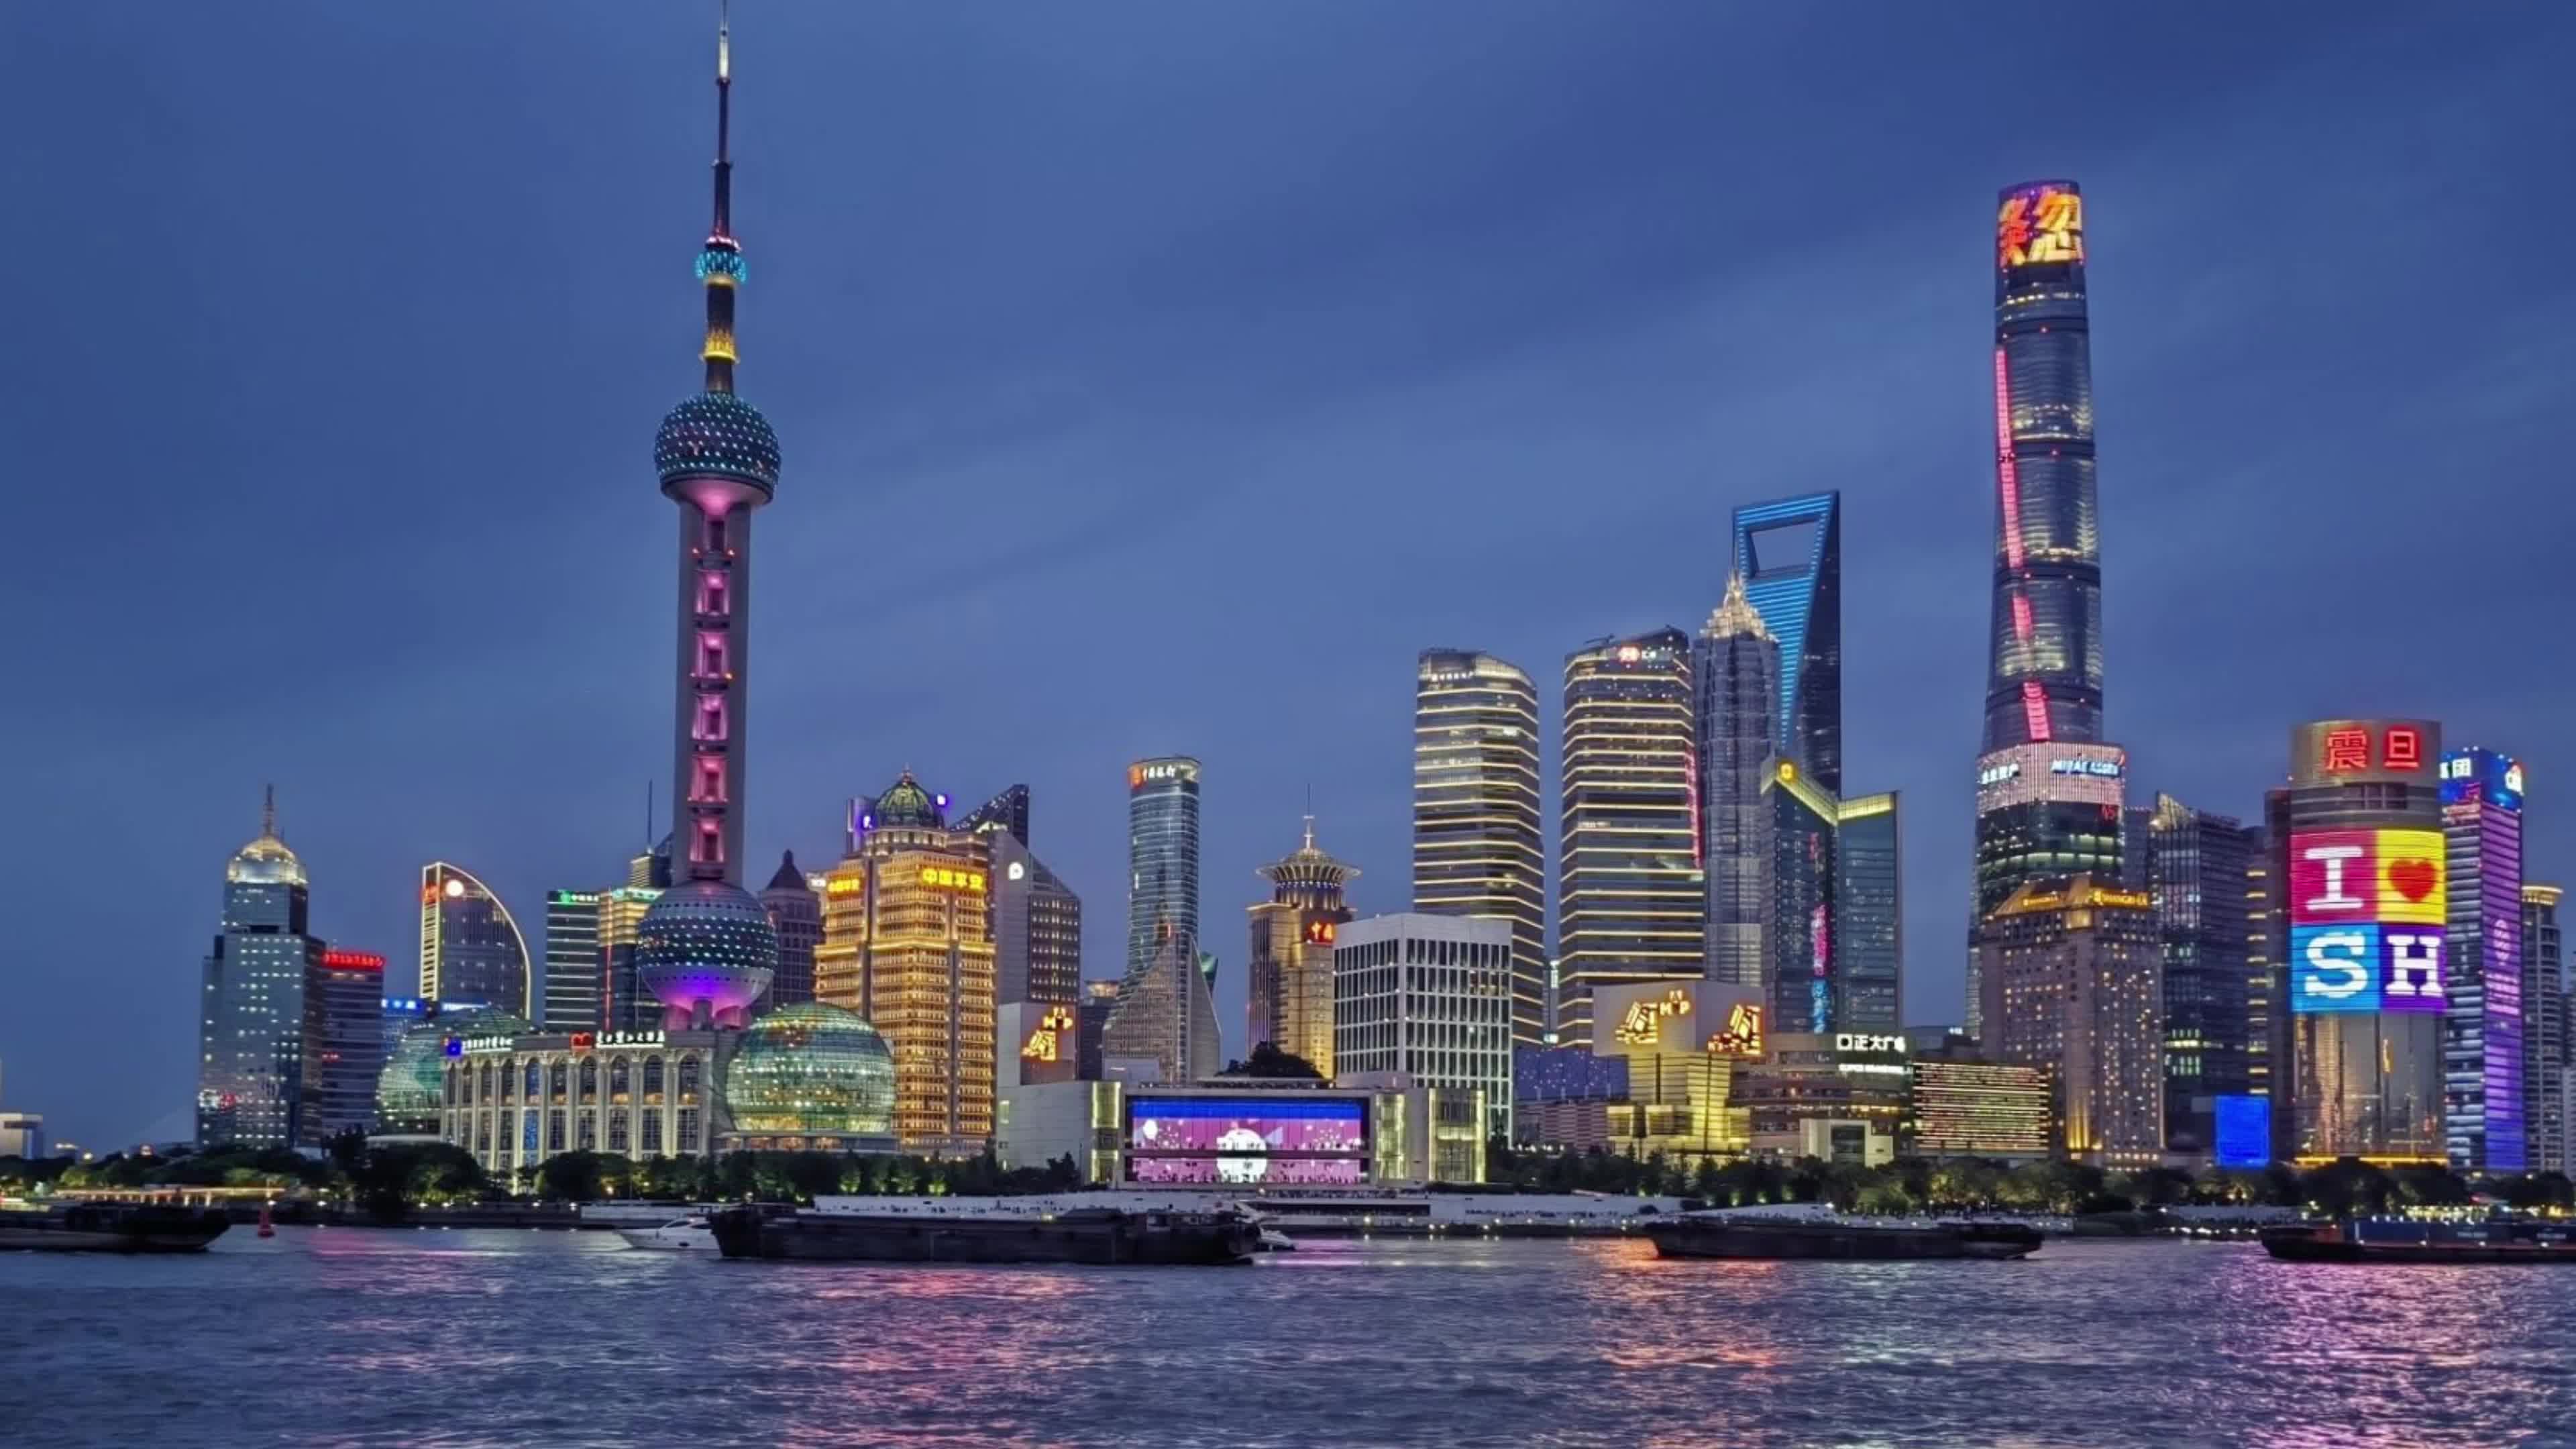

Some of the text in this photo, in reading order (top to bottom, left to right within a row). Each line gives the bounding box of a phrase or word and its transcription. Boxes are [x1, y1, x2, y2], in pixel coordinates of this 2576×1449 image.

[2327, 730, 2419, 769] 震旦
[2304, 846, 2365, 911] I
[2304, 931, 2445, 998] SH
